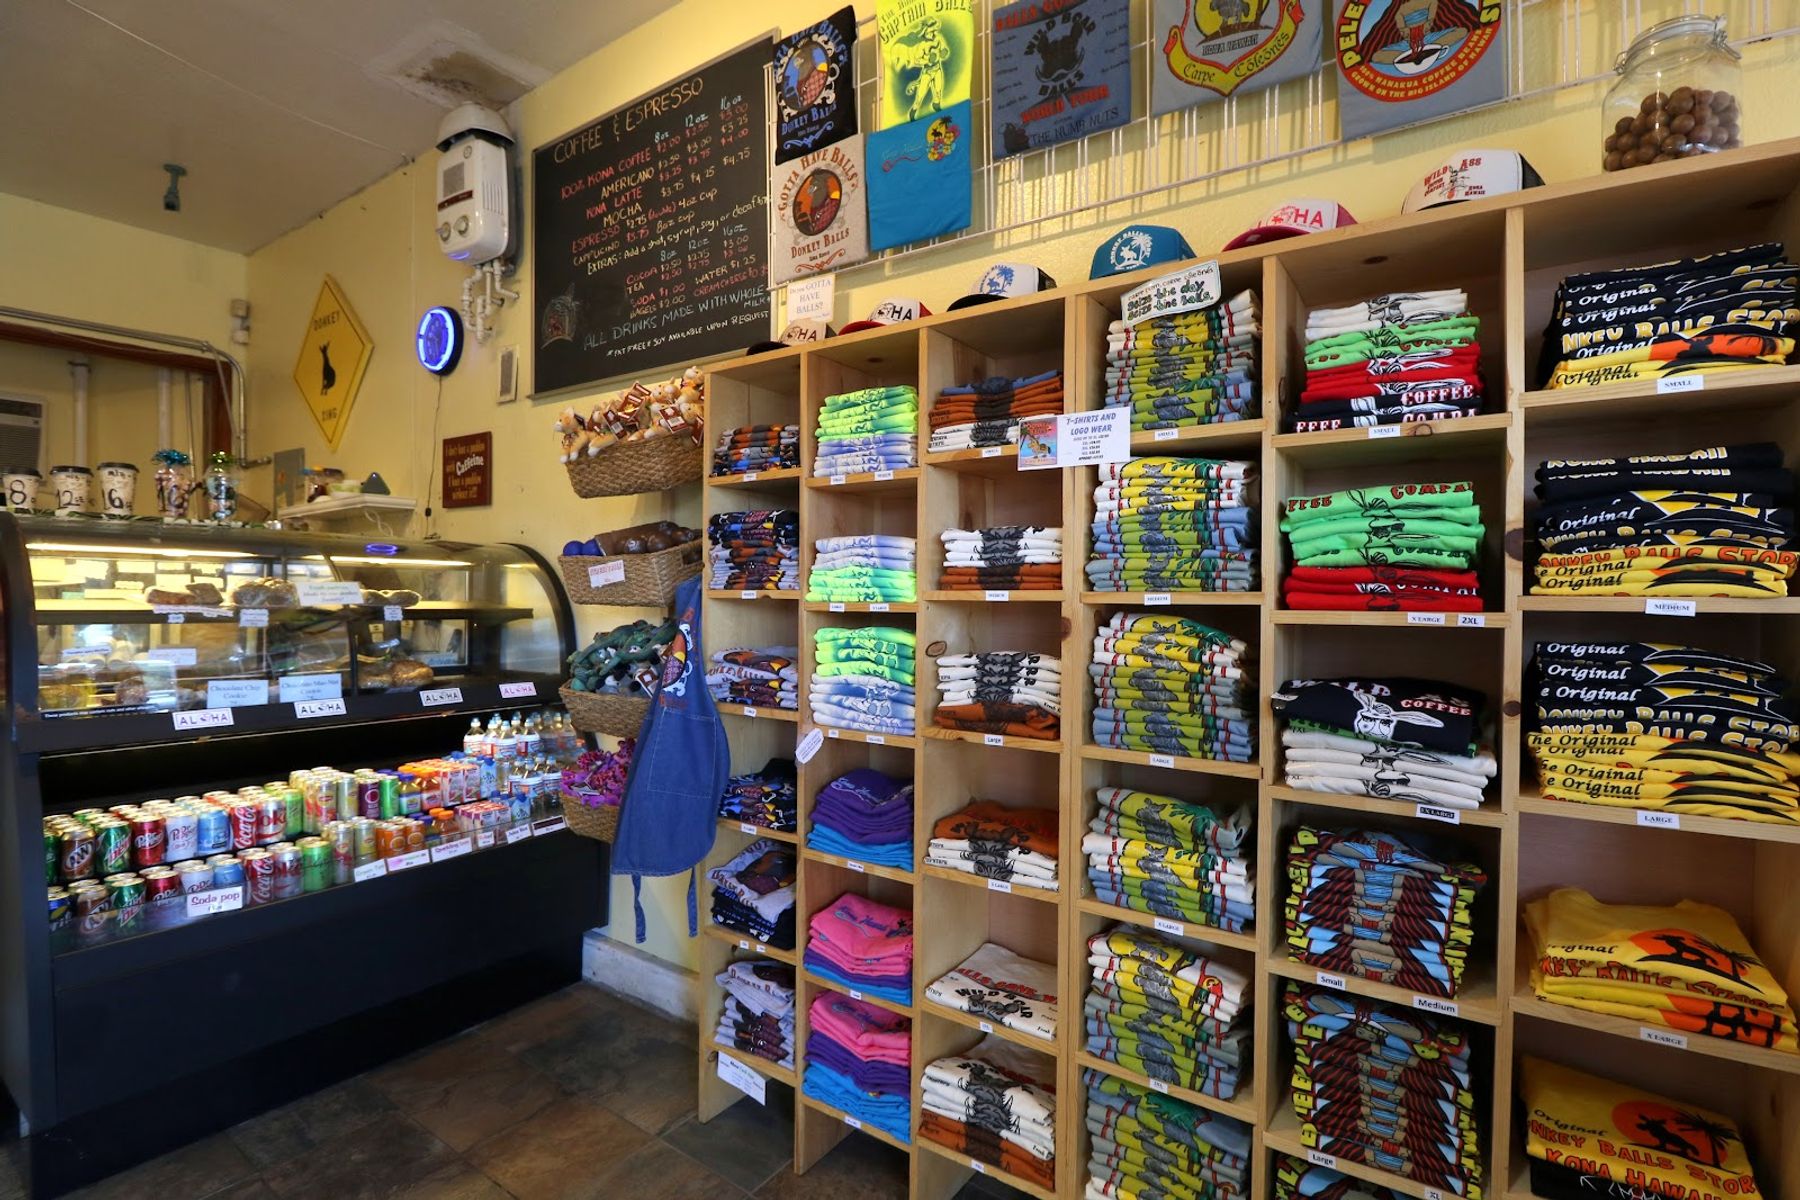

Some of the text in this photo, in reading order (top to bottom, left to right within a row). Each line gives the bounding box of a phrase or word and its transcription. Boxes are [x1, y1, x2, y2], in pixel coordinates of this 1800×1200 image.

[1422, 58, 1458, 83] COFFEE
[1458, 29, 1482, 61] BEANS
[1184, 62, 1216, 88] Carpe
[1351, 71, 1376, 92] GROWN
[1376, 88, 1387, 96] ON
[1408, 87, 1424, 98] BIG
[1425, 71, 1457, 92] ISLAND
[1458, 60, 1470, 72] OF
[554, 77, 704, 164] COFFEE ESPRESSO
[1031, 131, 1052, 144] THE
[1090, 107, 1119, 126] NUTS
[587, 166, 614, 186] KONA
[618, 147, 651, 172] COFFEE
[1424, 165, 1448, 186] WILD
[601, 166, 655, 200] AMERICANO
[778, 171, 800, 212] GOTTA
[800, 148, 828, 170] HAVE
[586, 202, 608, 220] KONA
[614, 186, 643, 208] LATTE
[602, 202, 643, 228] MOCHA
[570, 225, 620, 254] ESPRESSO
[790, 239, 820, 259] DONKEY
[824, 227, 850, 247] BALLS
[624, 245, 640, 260] Add
[626, 282, 645, 294] TEA
[630, 293, 656, 308] SODA
[695, 265, 728, 285] WATER
[806, 280, 832, 290] GOTTA
[800, 292, 820, 302] HAVE
[1579, 288, 1658, 306] Original
[583, 284, 766, 351] ALL DRINKS MADE WITH WHOLE
[796, 302, 824, 314] BALLS?
[313, 310, 340, 332] DONKEY
[730, 310, 769, 326] REQUEST
[1664, 380, 1693, 388] SMALL
[1401, 384, 1475, 406] COFFEE
[1066, 412, 1116, 426] T-SHIRTS AND
[1070, 424, 1112, 436] LOGO WEAR
[456, 454, 484, 476] Caffeine
[10, 480, 27, 505] 8
[1560, 506, 1641, 532] Original
[1556, 558, 1634, 577] Original
[1545, 572, 1624, 590] Original
[1654, 604, 1690, 612] MEDIUM
[1462, 616, 1478, 625] 2XL
[1547, 642, 1630, 656] Original
[1548, 664, 1631, 682] Original
[1556, 686, 1642, 702] Original
[1400, 698, 1472, 716] COFFEE
[1560, 734, 1640, 749] Original
[1564, 762, 1644, 782] Original
[1562, 776, 1642, 798] Original
[1644, 815, 1672, 824] LARGE
[191, 892, 240, 906] Soda pop
[1320, 976, 1342, 988] Small
[1418, 999, 1456, 1012] Medium
[1654, 1035, 1684, 1046] LARGE
[1534, 1108, 1608, 1137] Original
[1312, 1153, 1334, 1166] Large
[1546, 1148, 1612, 1180] KONA
[1597, 1139, 1675, 1170] BALLS
